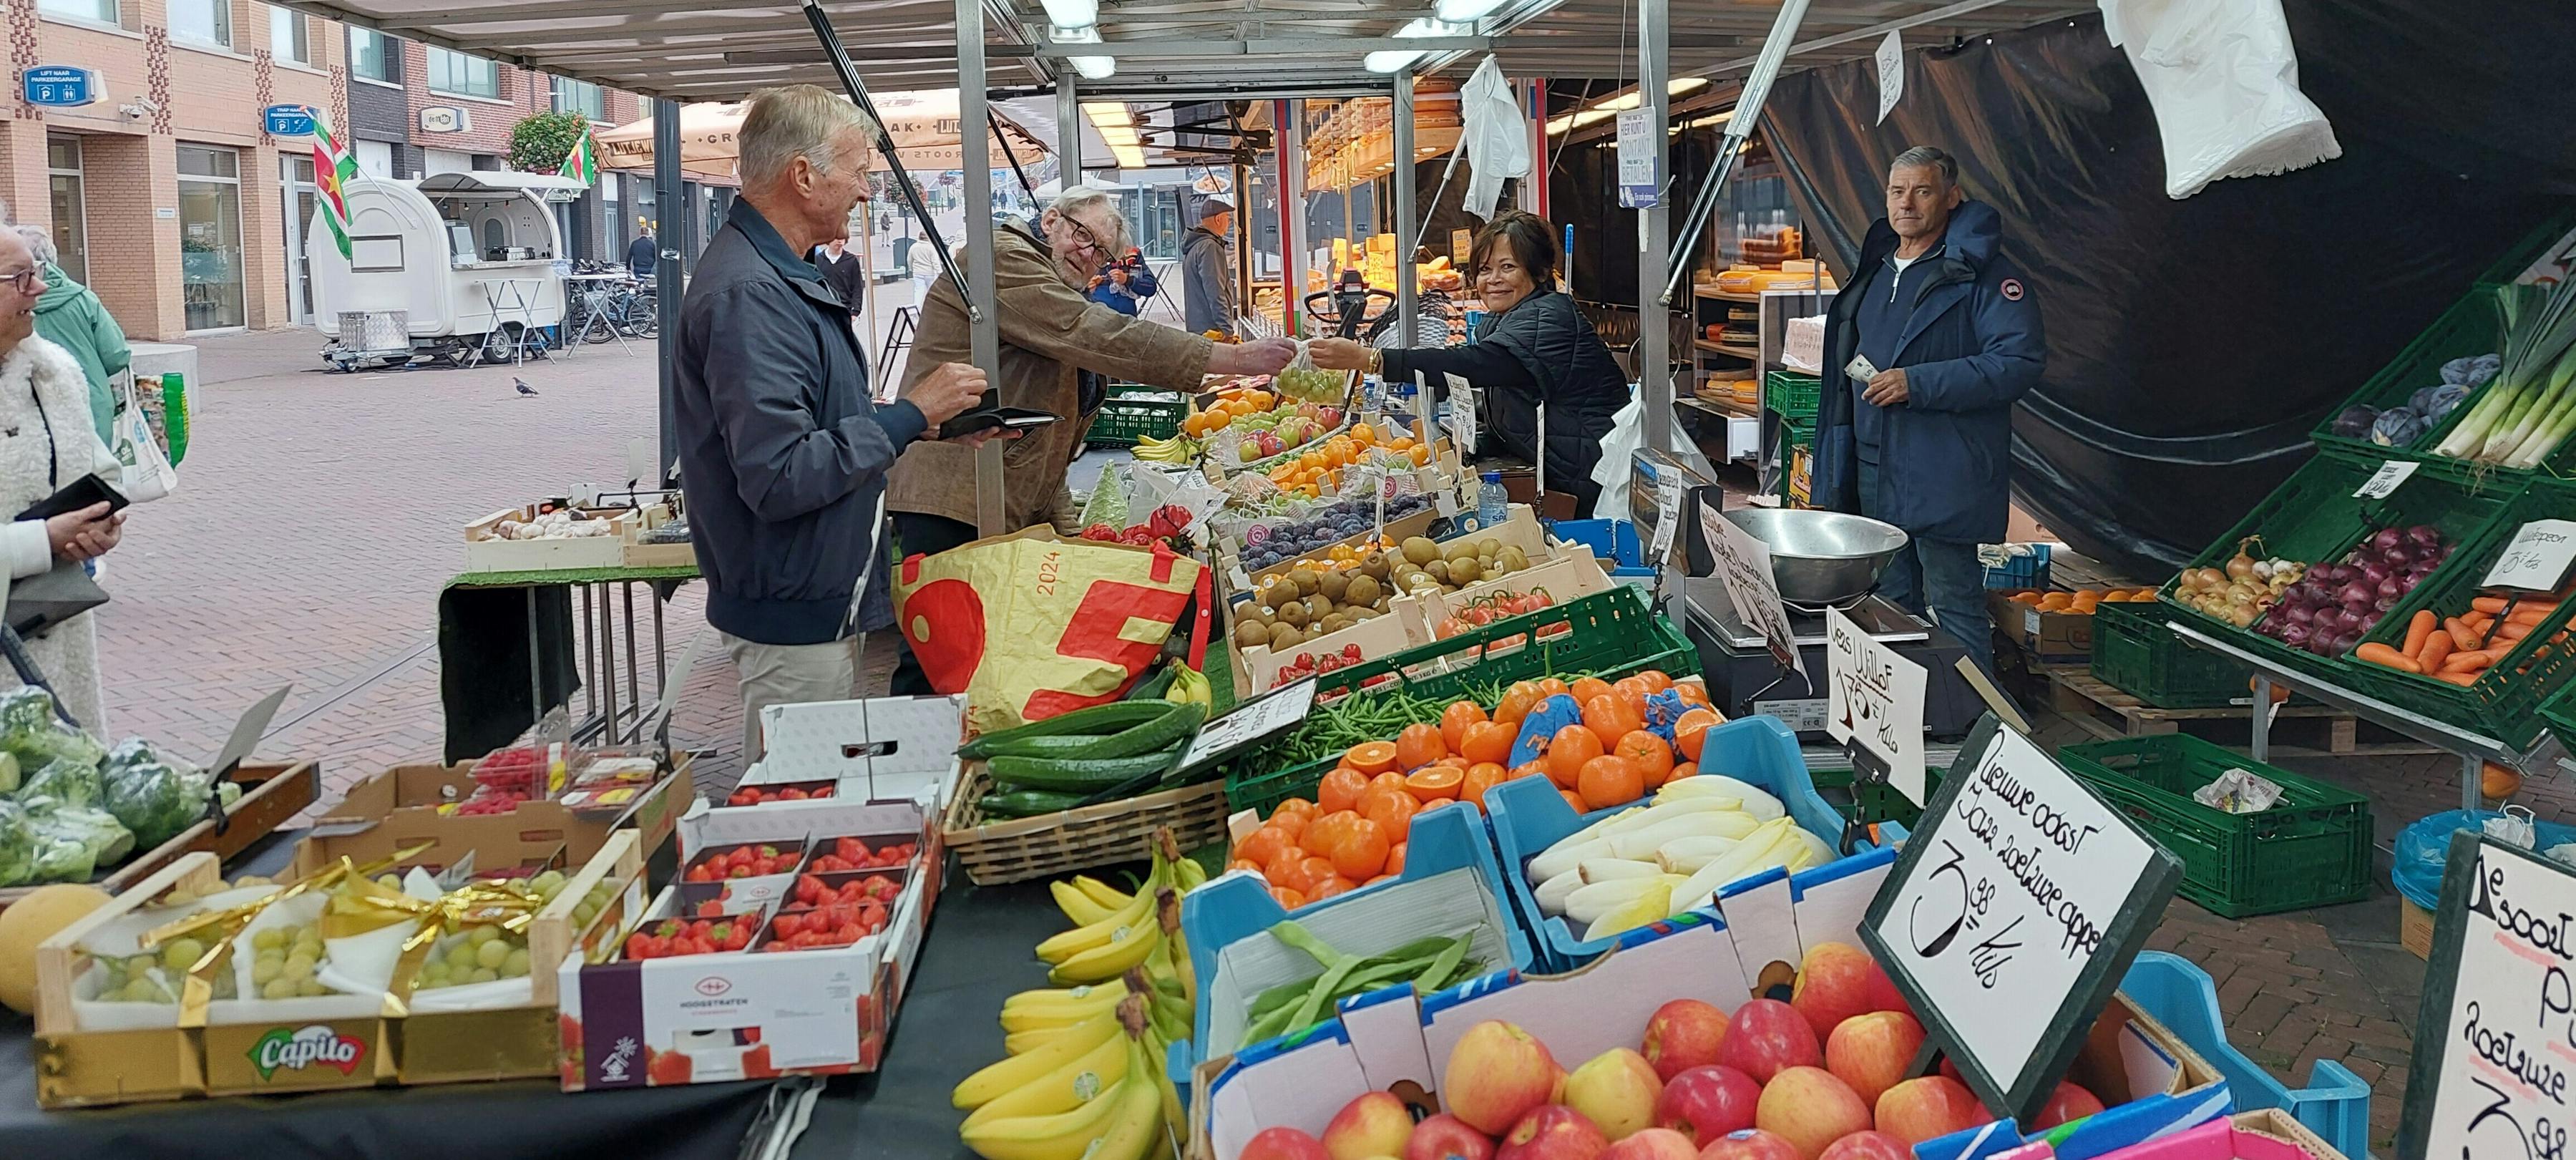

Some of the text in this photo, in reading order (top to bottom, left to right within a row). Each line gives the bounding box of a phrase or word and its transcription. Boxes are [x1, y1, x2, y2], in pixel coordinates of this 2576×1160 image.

[1620, 123, 1630, 136] HIER
[1631, 122, 1642, 135] KUNT
[1621, 138, 1650, 157] CONTANT
[1621, 166, 1652, 183] BETALEN
[1037, 552, 1060, 596] 2024
